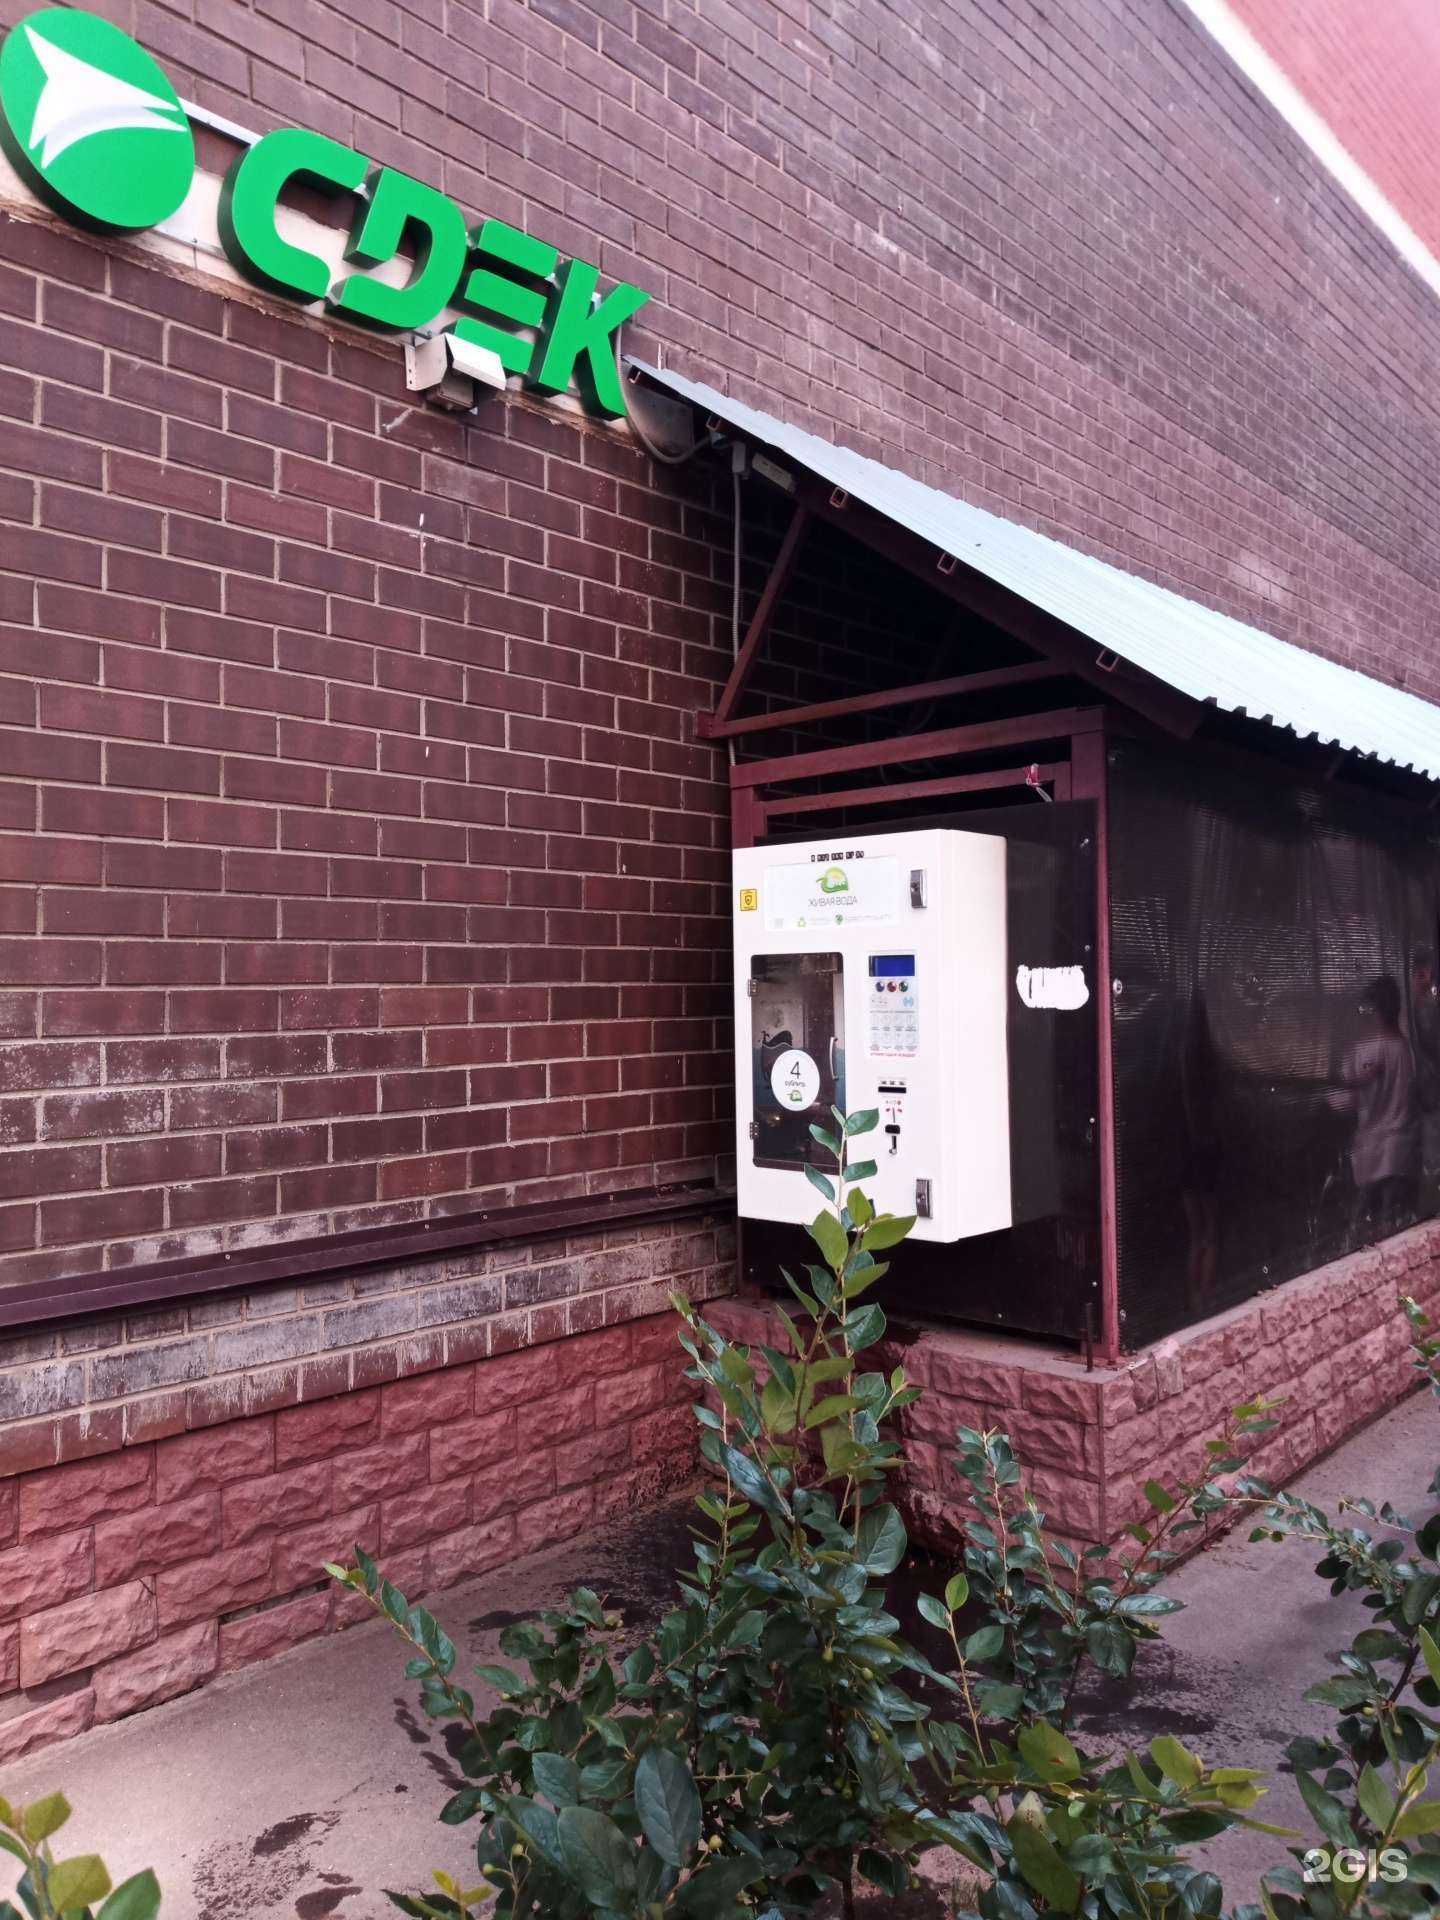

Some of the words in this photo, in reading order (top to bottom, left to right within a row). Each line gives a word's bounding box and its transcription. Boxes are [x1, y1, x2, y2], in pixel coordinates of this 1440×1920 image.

[219, 128, 650, 419] CDEK
[835, 895, 858, 906] ВОДА
[790, 1061, 801, 1079] 4
